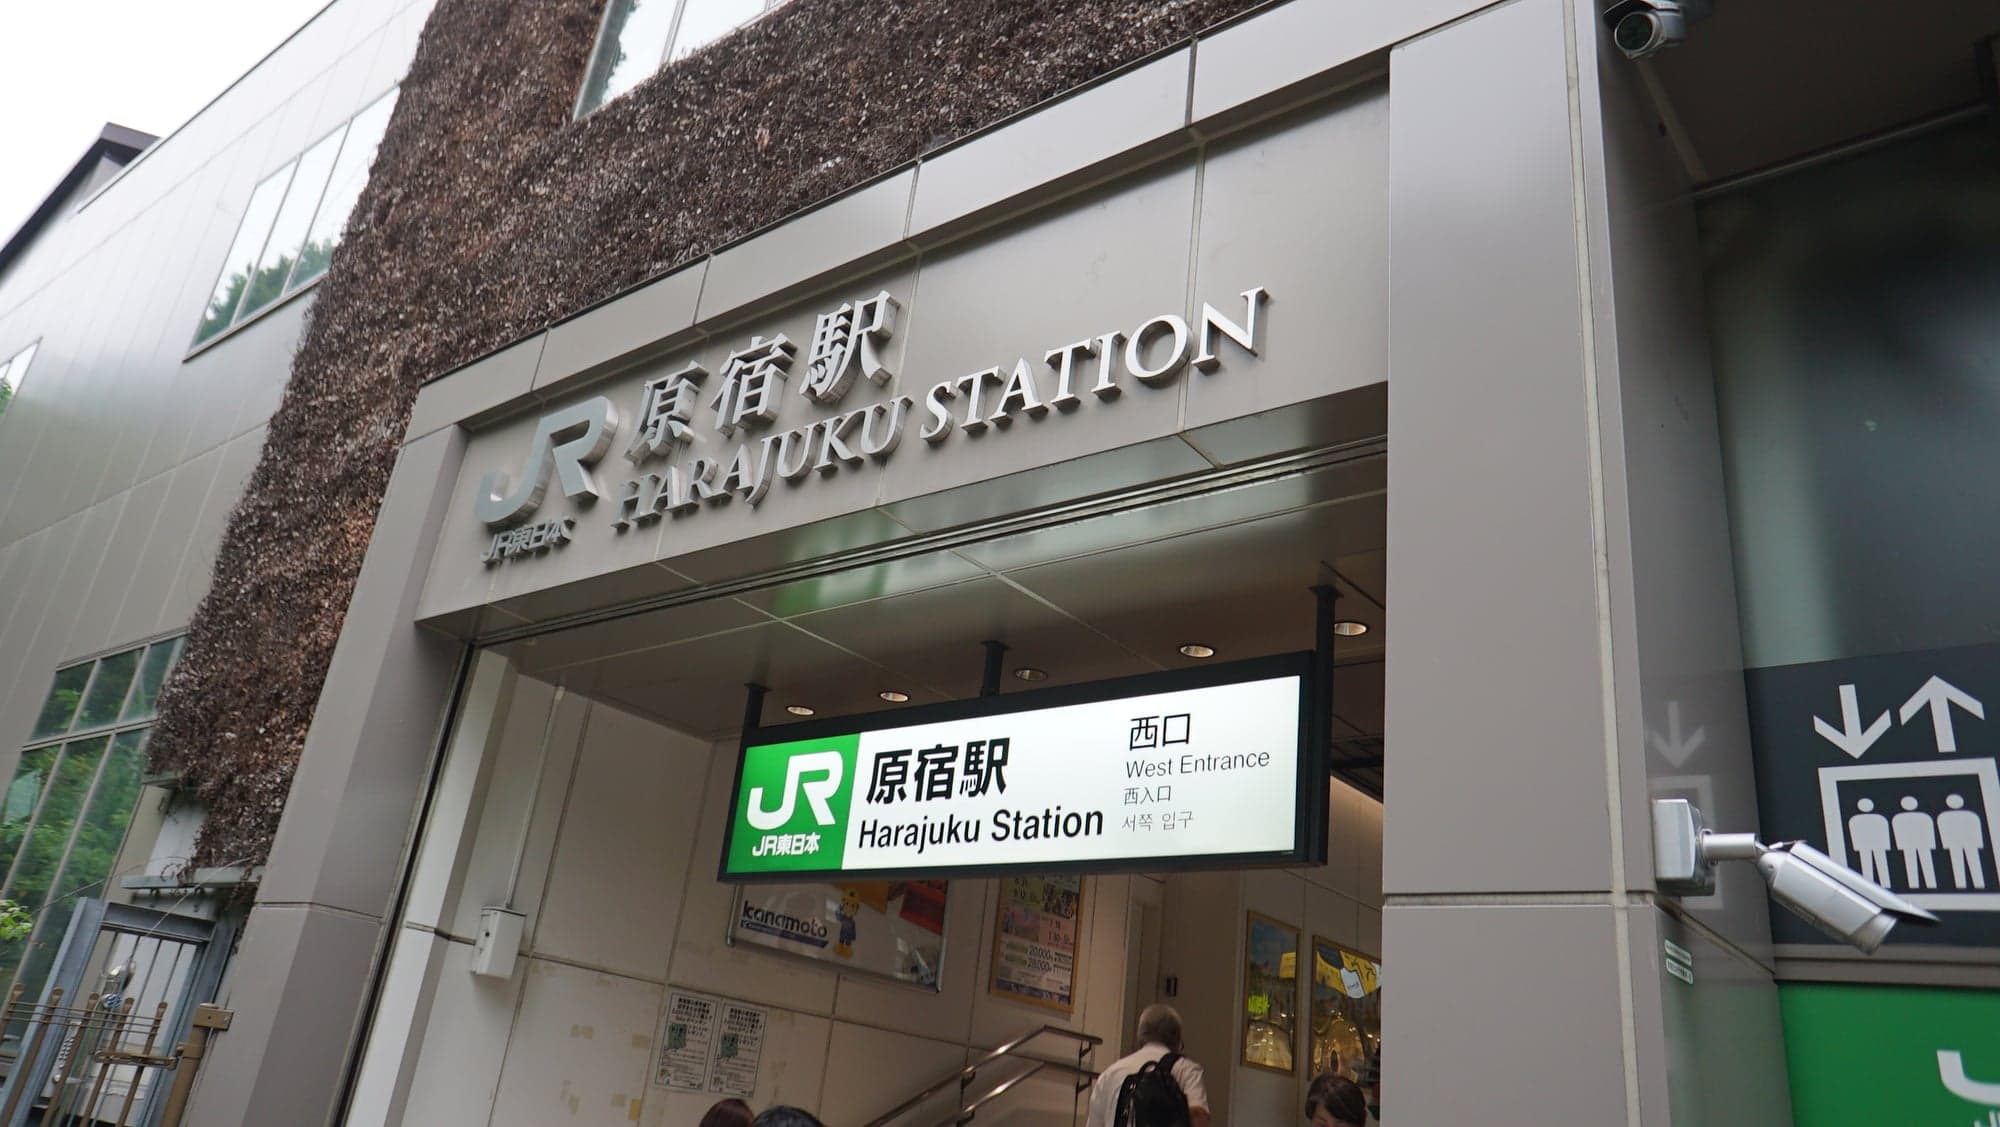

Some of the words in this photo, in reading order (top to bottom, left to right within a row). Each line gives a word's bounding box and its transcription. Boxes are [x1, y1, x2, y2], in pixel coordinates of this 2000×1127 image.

[623, 290, 900, 465] 原宿駅
[611, 396, 913, 530] HARAJUKU
[919, 285, 1270, 443] STATION
[475, 395, 620, 528] JR
[480, 514, 576, 564] JR東日本
[1128, 712, 1191, 751] 西口
[746, 750, 844, 830] JR
[865, 736, 1011, 805] 原宿駅
[1126, 758, 1173, 779] West
[1180, 751, 1271, 774] Entrance
[1123, 785, 1172, 806] 西入口
[751, 832, 821, 857] JR東日本
[858, 813, 981, 855] Harajuku
[991, 805, 1104, 842] Station
[1121, 812, 1153, 832] 서쪽
[1161, 810, 1195, 831] 입구
[742, 900, 828, 938] kanamoto
